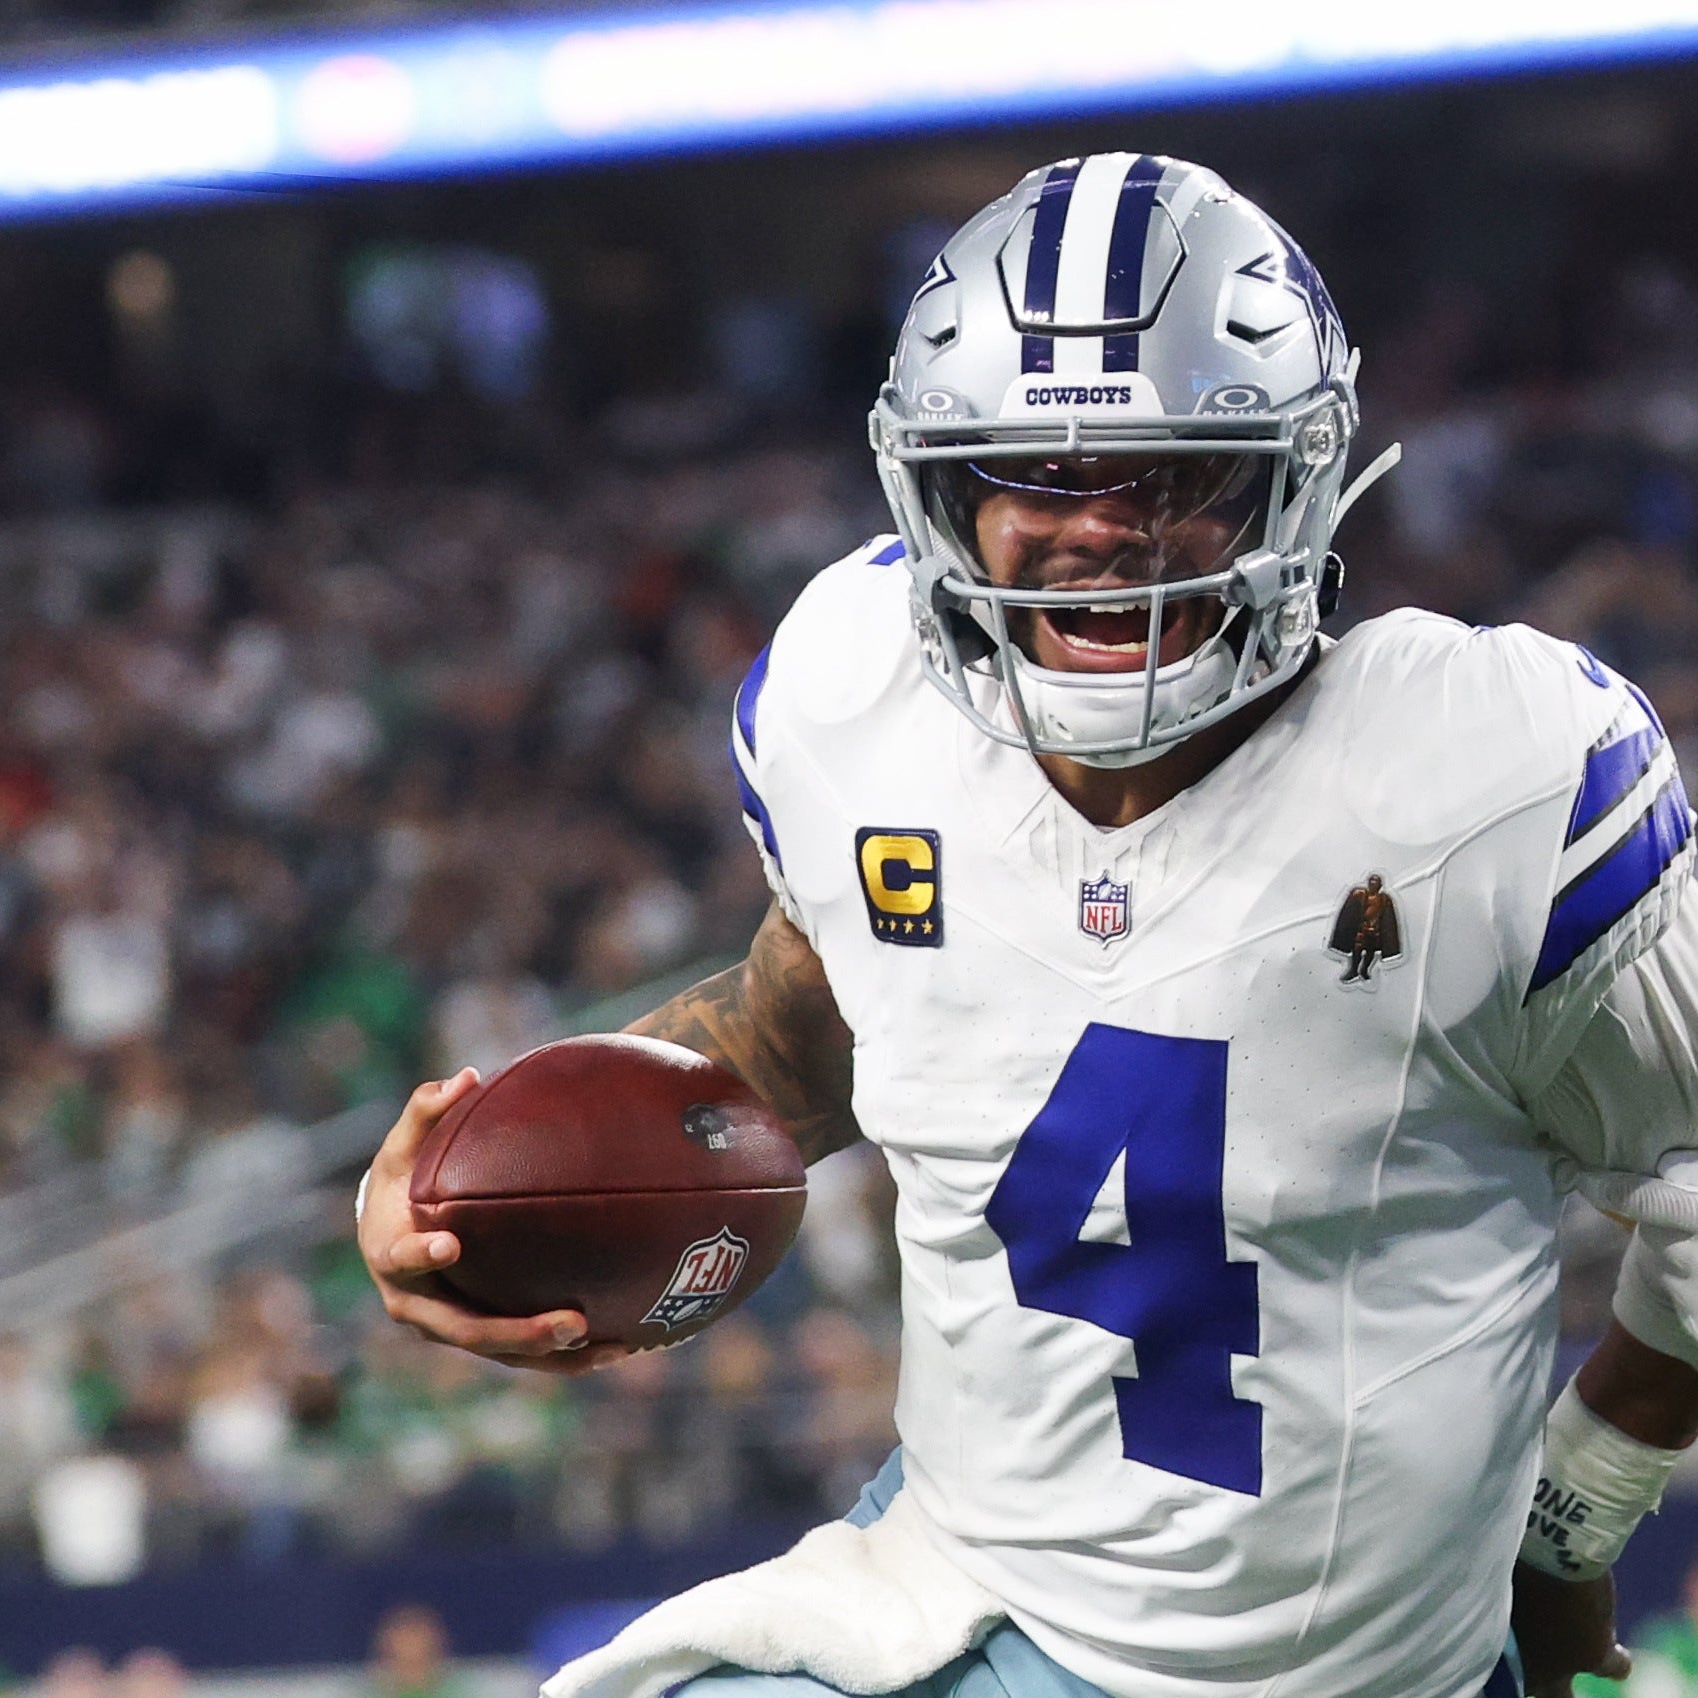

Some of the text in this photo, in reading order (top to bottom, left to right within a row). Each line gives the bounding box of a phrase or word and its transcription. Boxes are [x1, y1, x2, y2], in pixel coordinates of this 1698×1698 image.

[1025, 386, 1131, 406] COWBOYS
[860, 834, 935, 916] C
[1085, 905, 1123, 934] NFL
[680, 1244, 744, 1294] NFL
[984, 1021, 1263, 1498] 4
[1533, 1477, 1593, 1526] ONE
[1526, 1510, 1571, 1548] OVE
